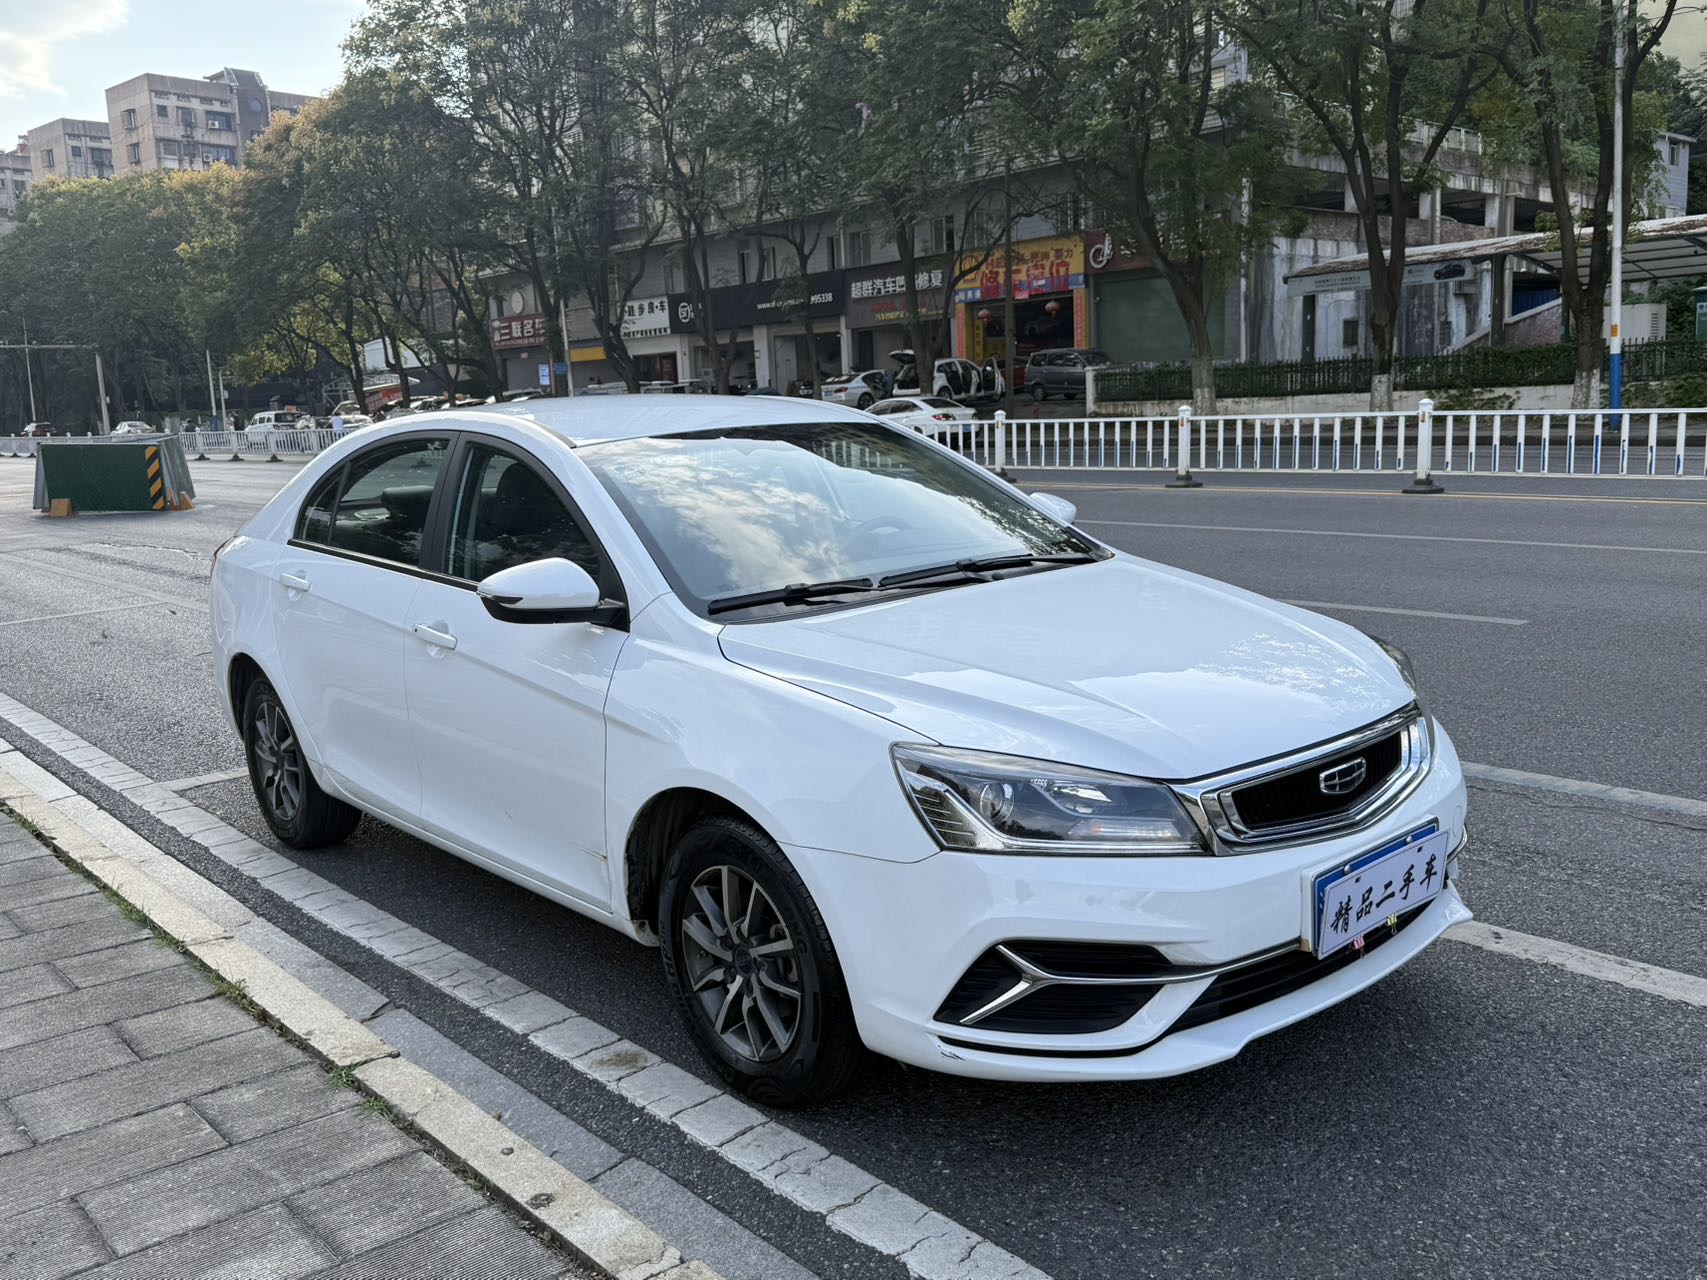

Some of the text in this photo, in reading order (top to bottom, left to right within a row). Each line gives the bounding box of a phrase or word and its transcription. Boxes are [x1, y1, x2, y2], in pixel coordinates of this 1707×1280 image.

[850, 269, 943, 299] 超群汽车凹修复
[1331, 854, 1438, 933] 精品二手车
